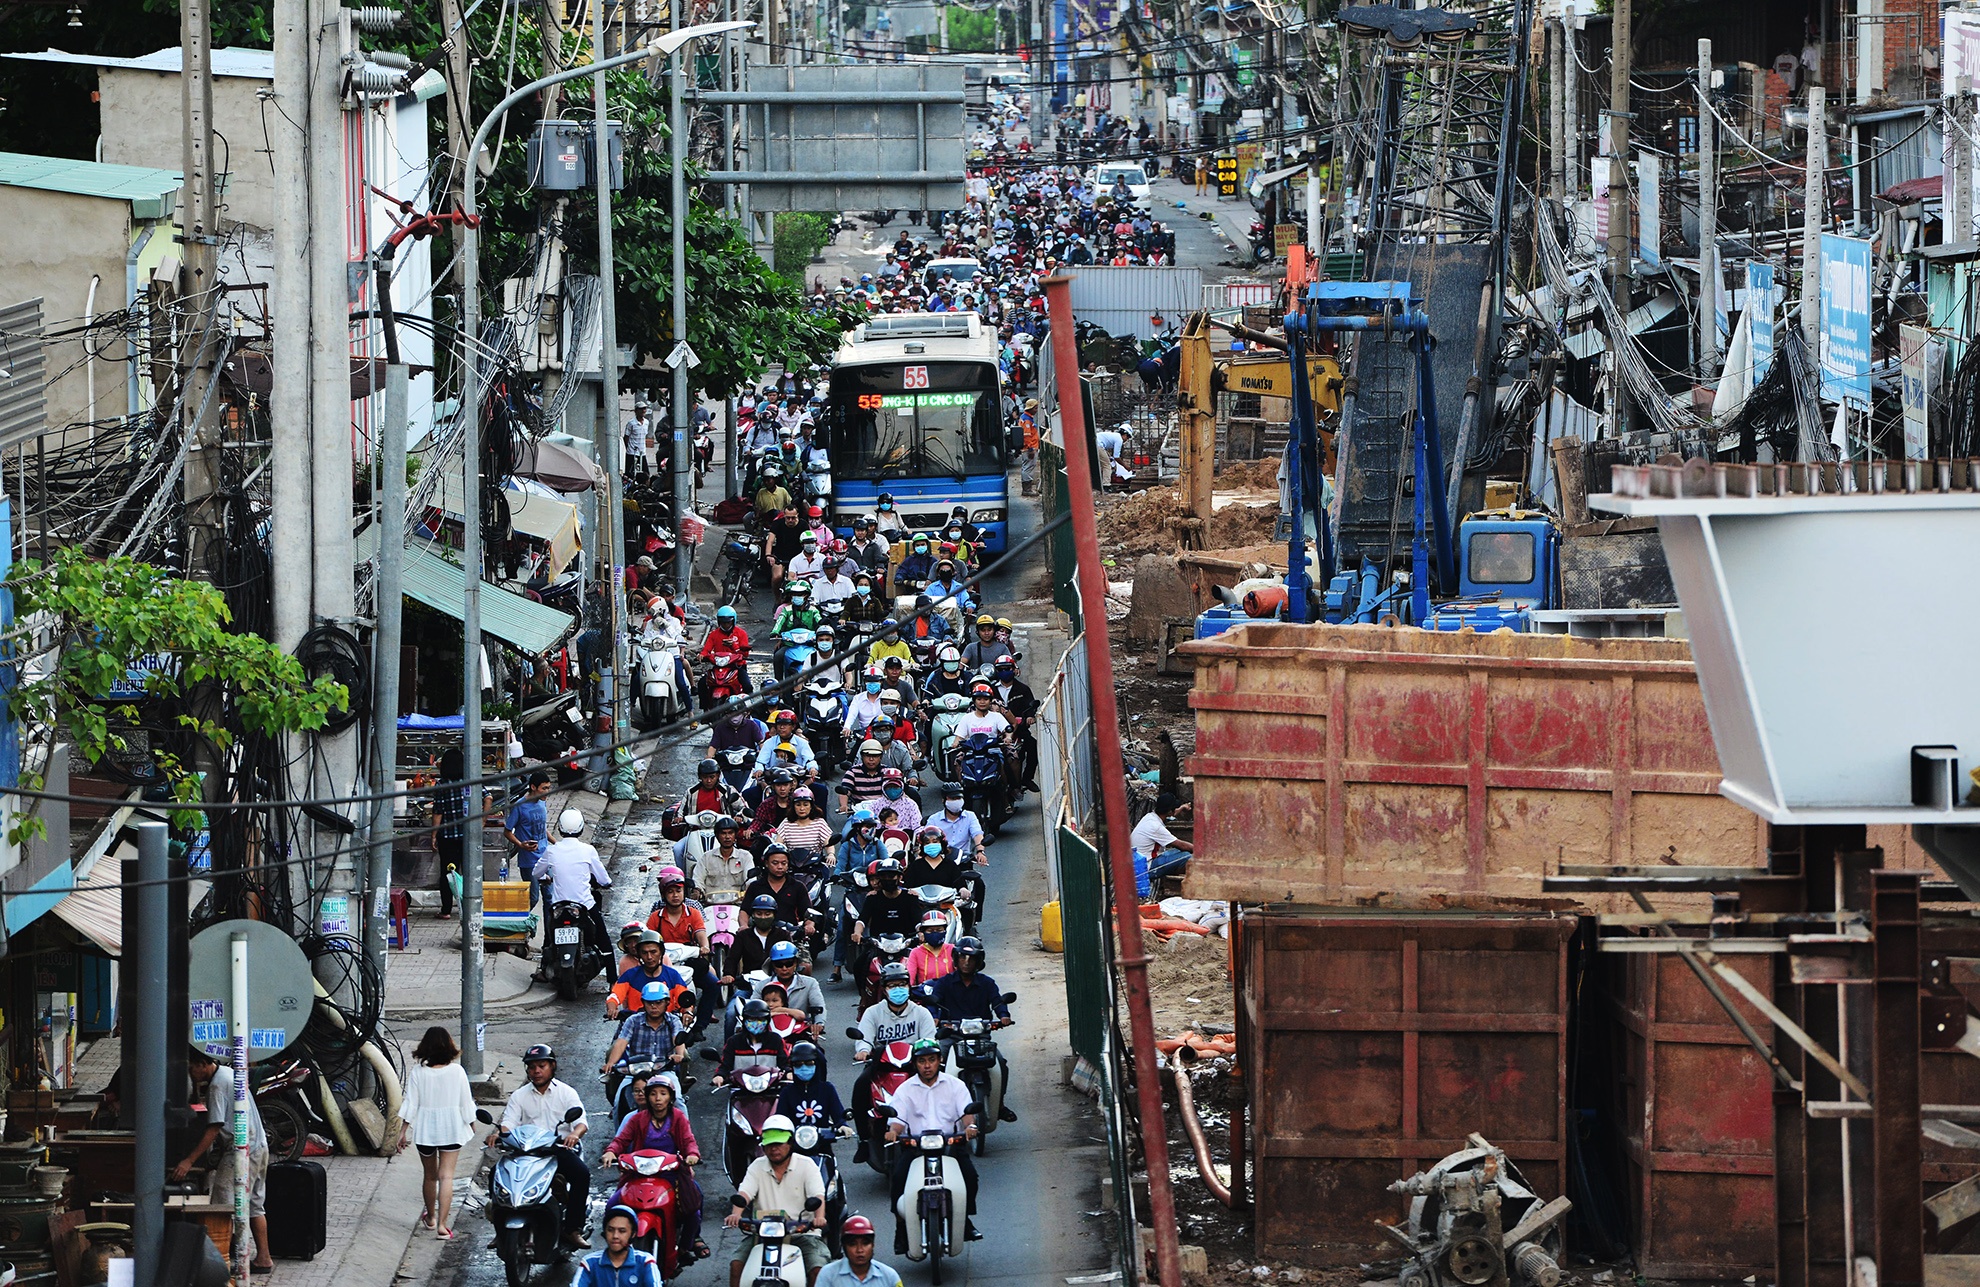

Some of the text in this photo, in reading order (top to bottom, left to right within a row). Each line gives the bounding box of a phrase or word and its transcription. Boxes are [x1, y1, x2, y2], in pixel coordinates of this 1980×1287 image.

[1217, 159, 1237, 169] BAO
[1218, 171, 1237, 181] CAO
[1222, 184, 1234, 194] SU
[905, 367, 927, 388] 55
[1241, 375, 1273, 390] KOMATSU
[858, 394, 882, 409] 55
[929, 394, 953, 406] CNC
[954, 394, 974, 405] QU
[878, 1020, 916, 1040] G.S.RAW
